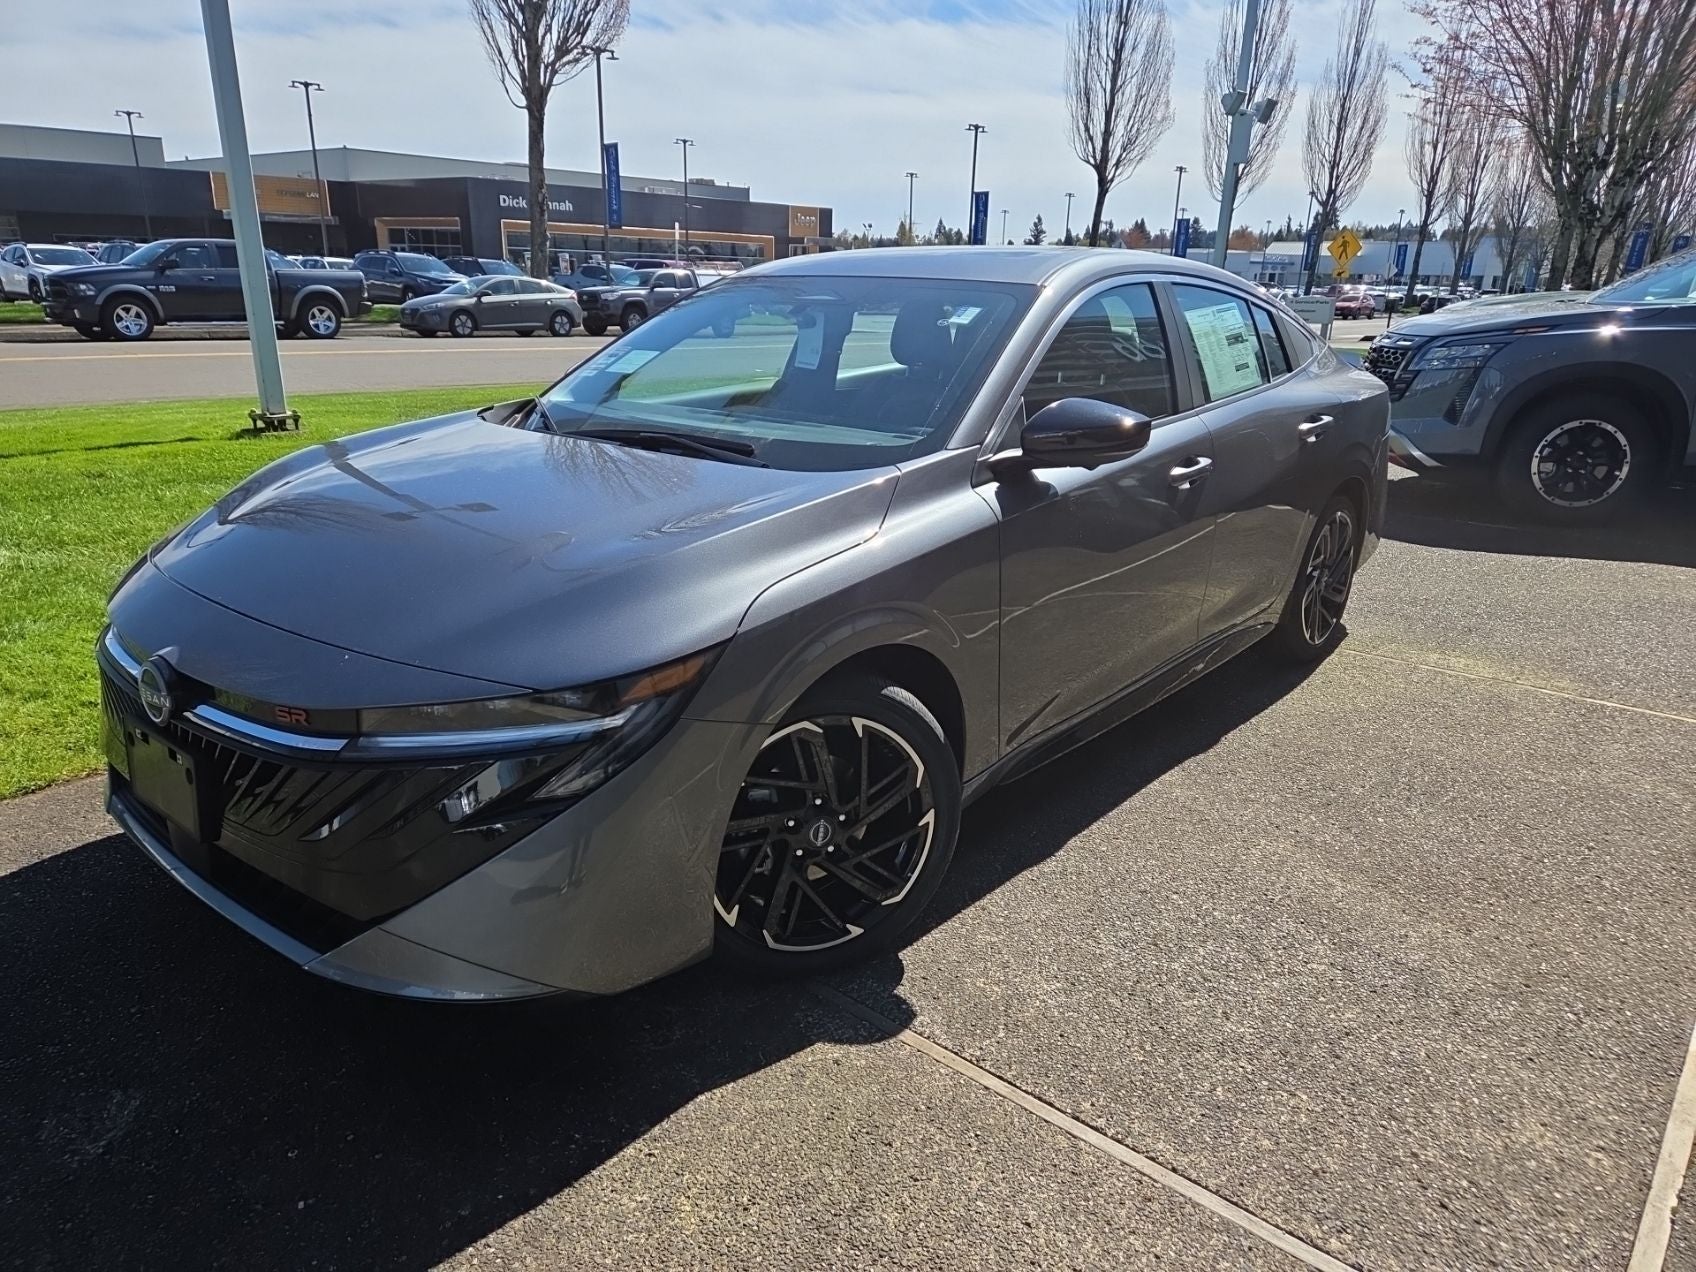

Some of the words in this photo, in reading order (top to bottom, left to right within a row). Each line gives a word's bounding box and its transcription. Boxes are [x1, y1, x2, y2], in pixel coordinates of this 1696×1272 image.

[499, 194, 528, 209] Dick
[546, 200, 574, 212] nnah
[794, 212, 817, 229] Jeep
[274, 706, 310, 727] SR
